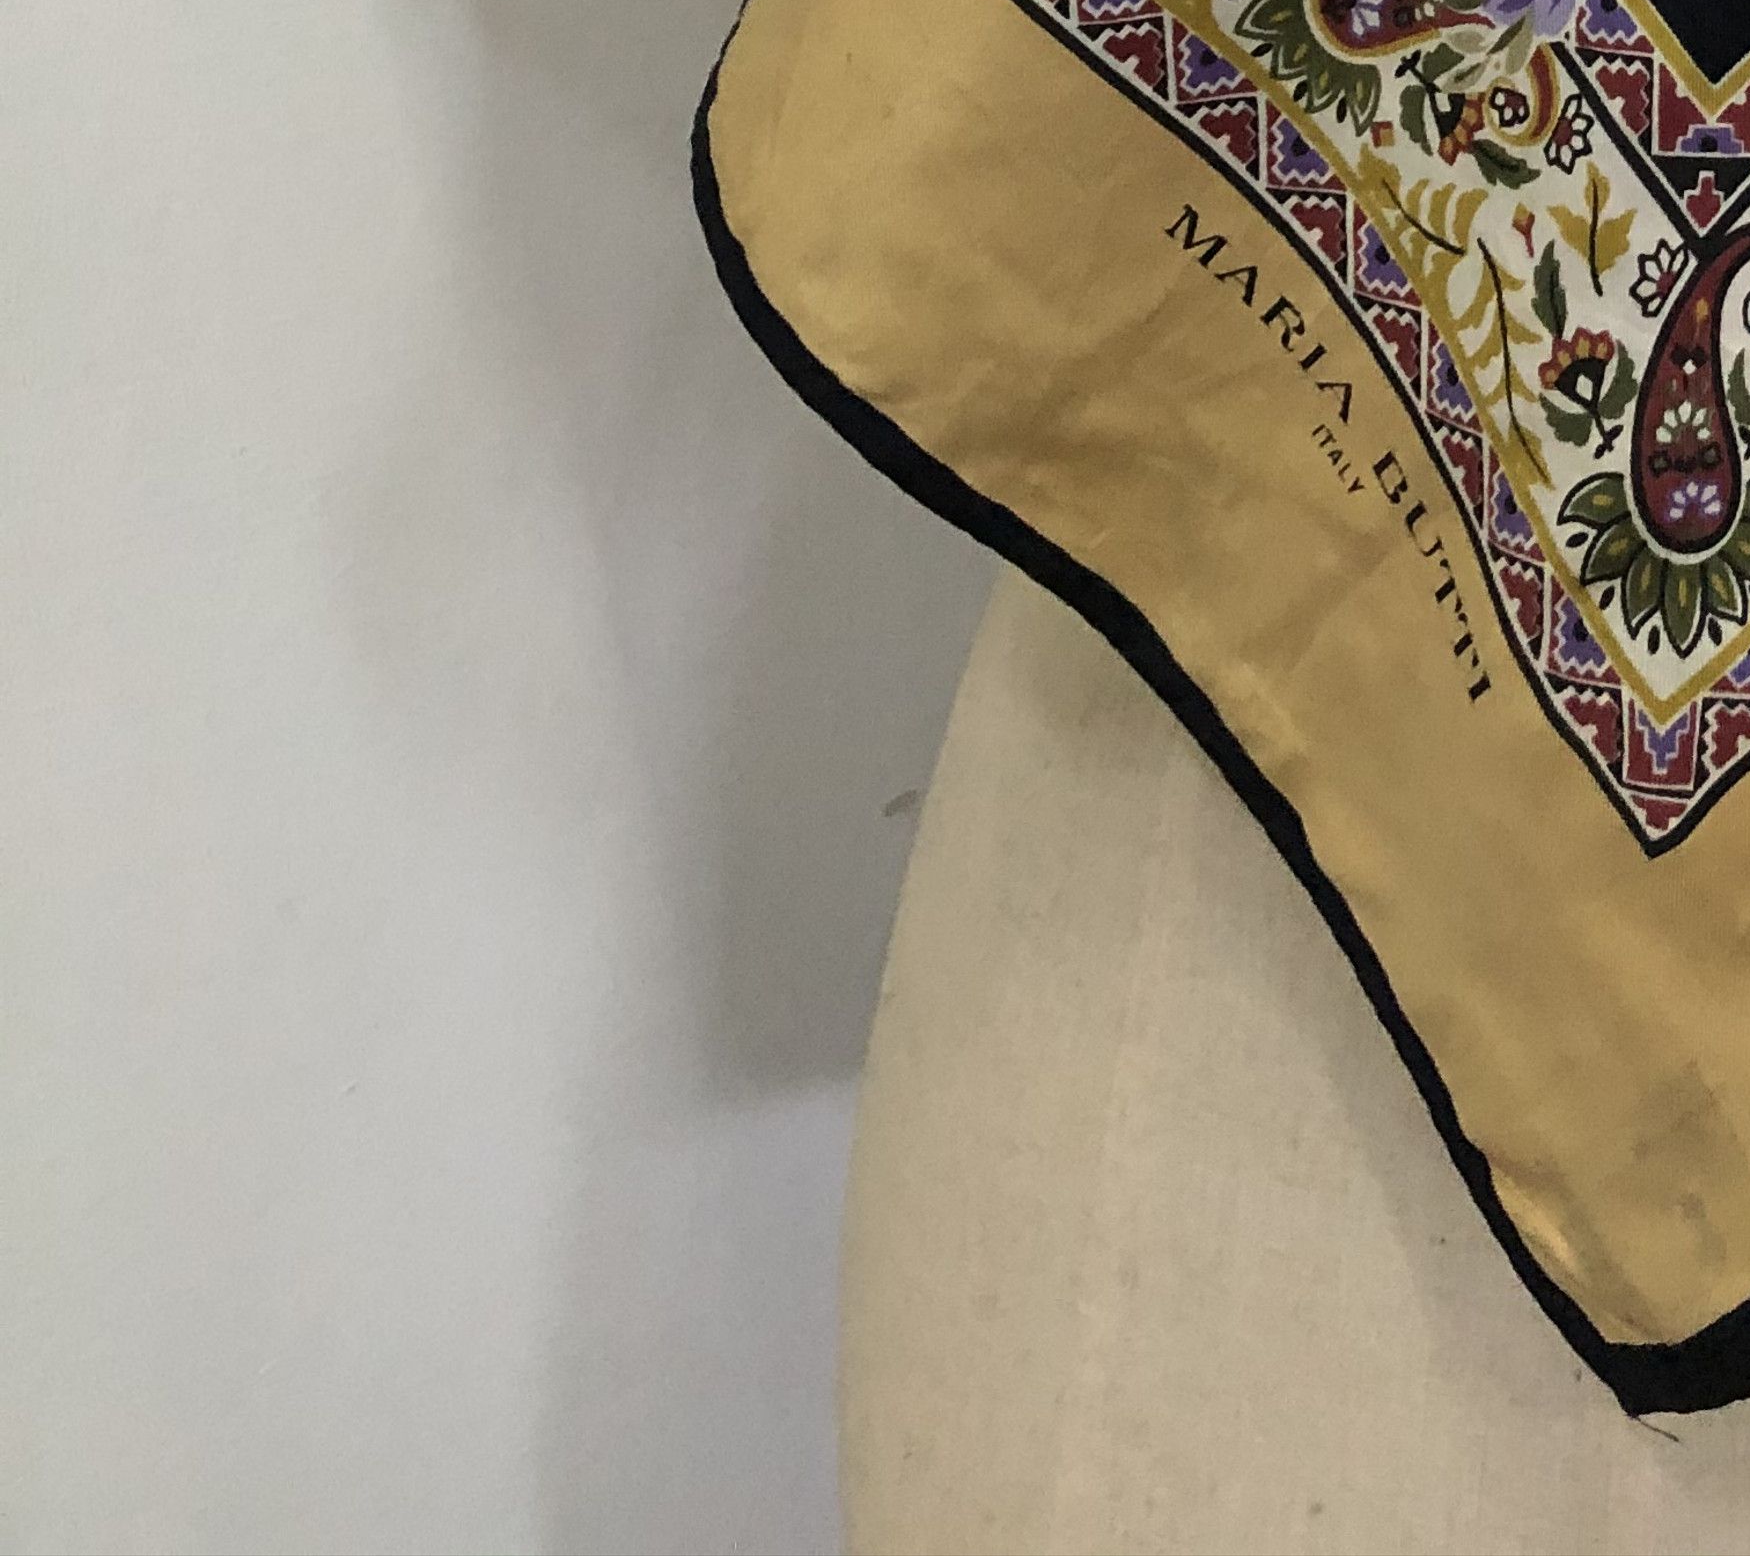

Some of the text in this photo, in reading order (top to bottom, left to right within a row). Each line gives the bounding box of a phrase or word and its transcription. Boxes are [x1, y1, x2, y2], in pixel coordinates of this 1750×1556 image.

[1164, 203, 1492, 704] MARIA BUTTI
[1311, 423, 1366, 495] ITALY
